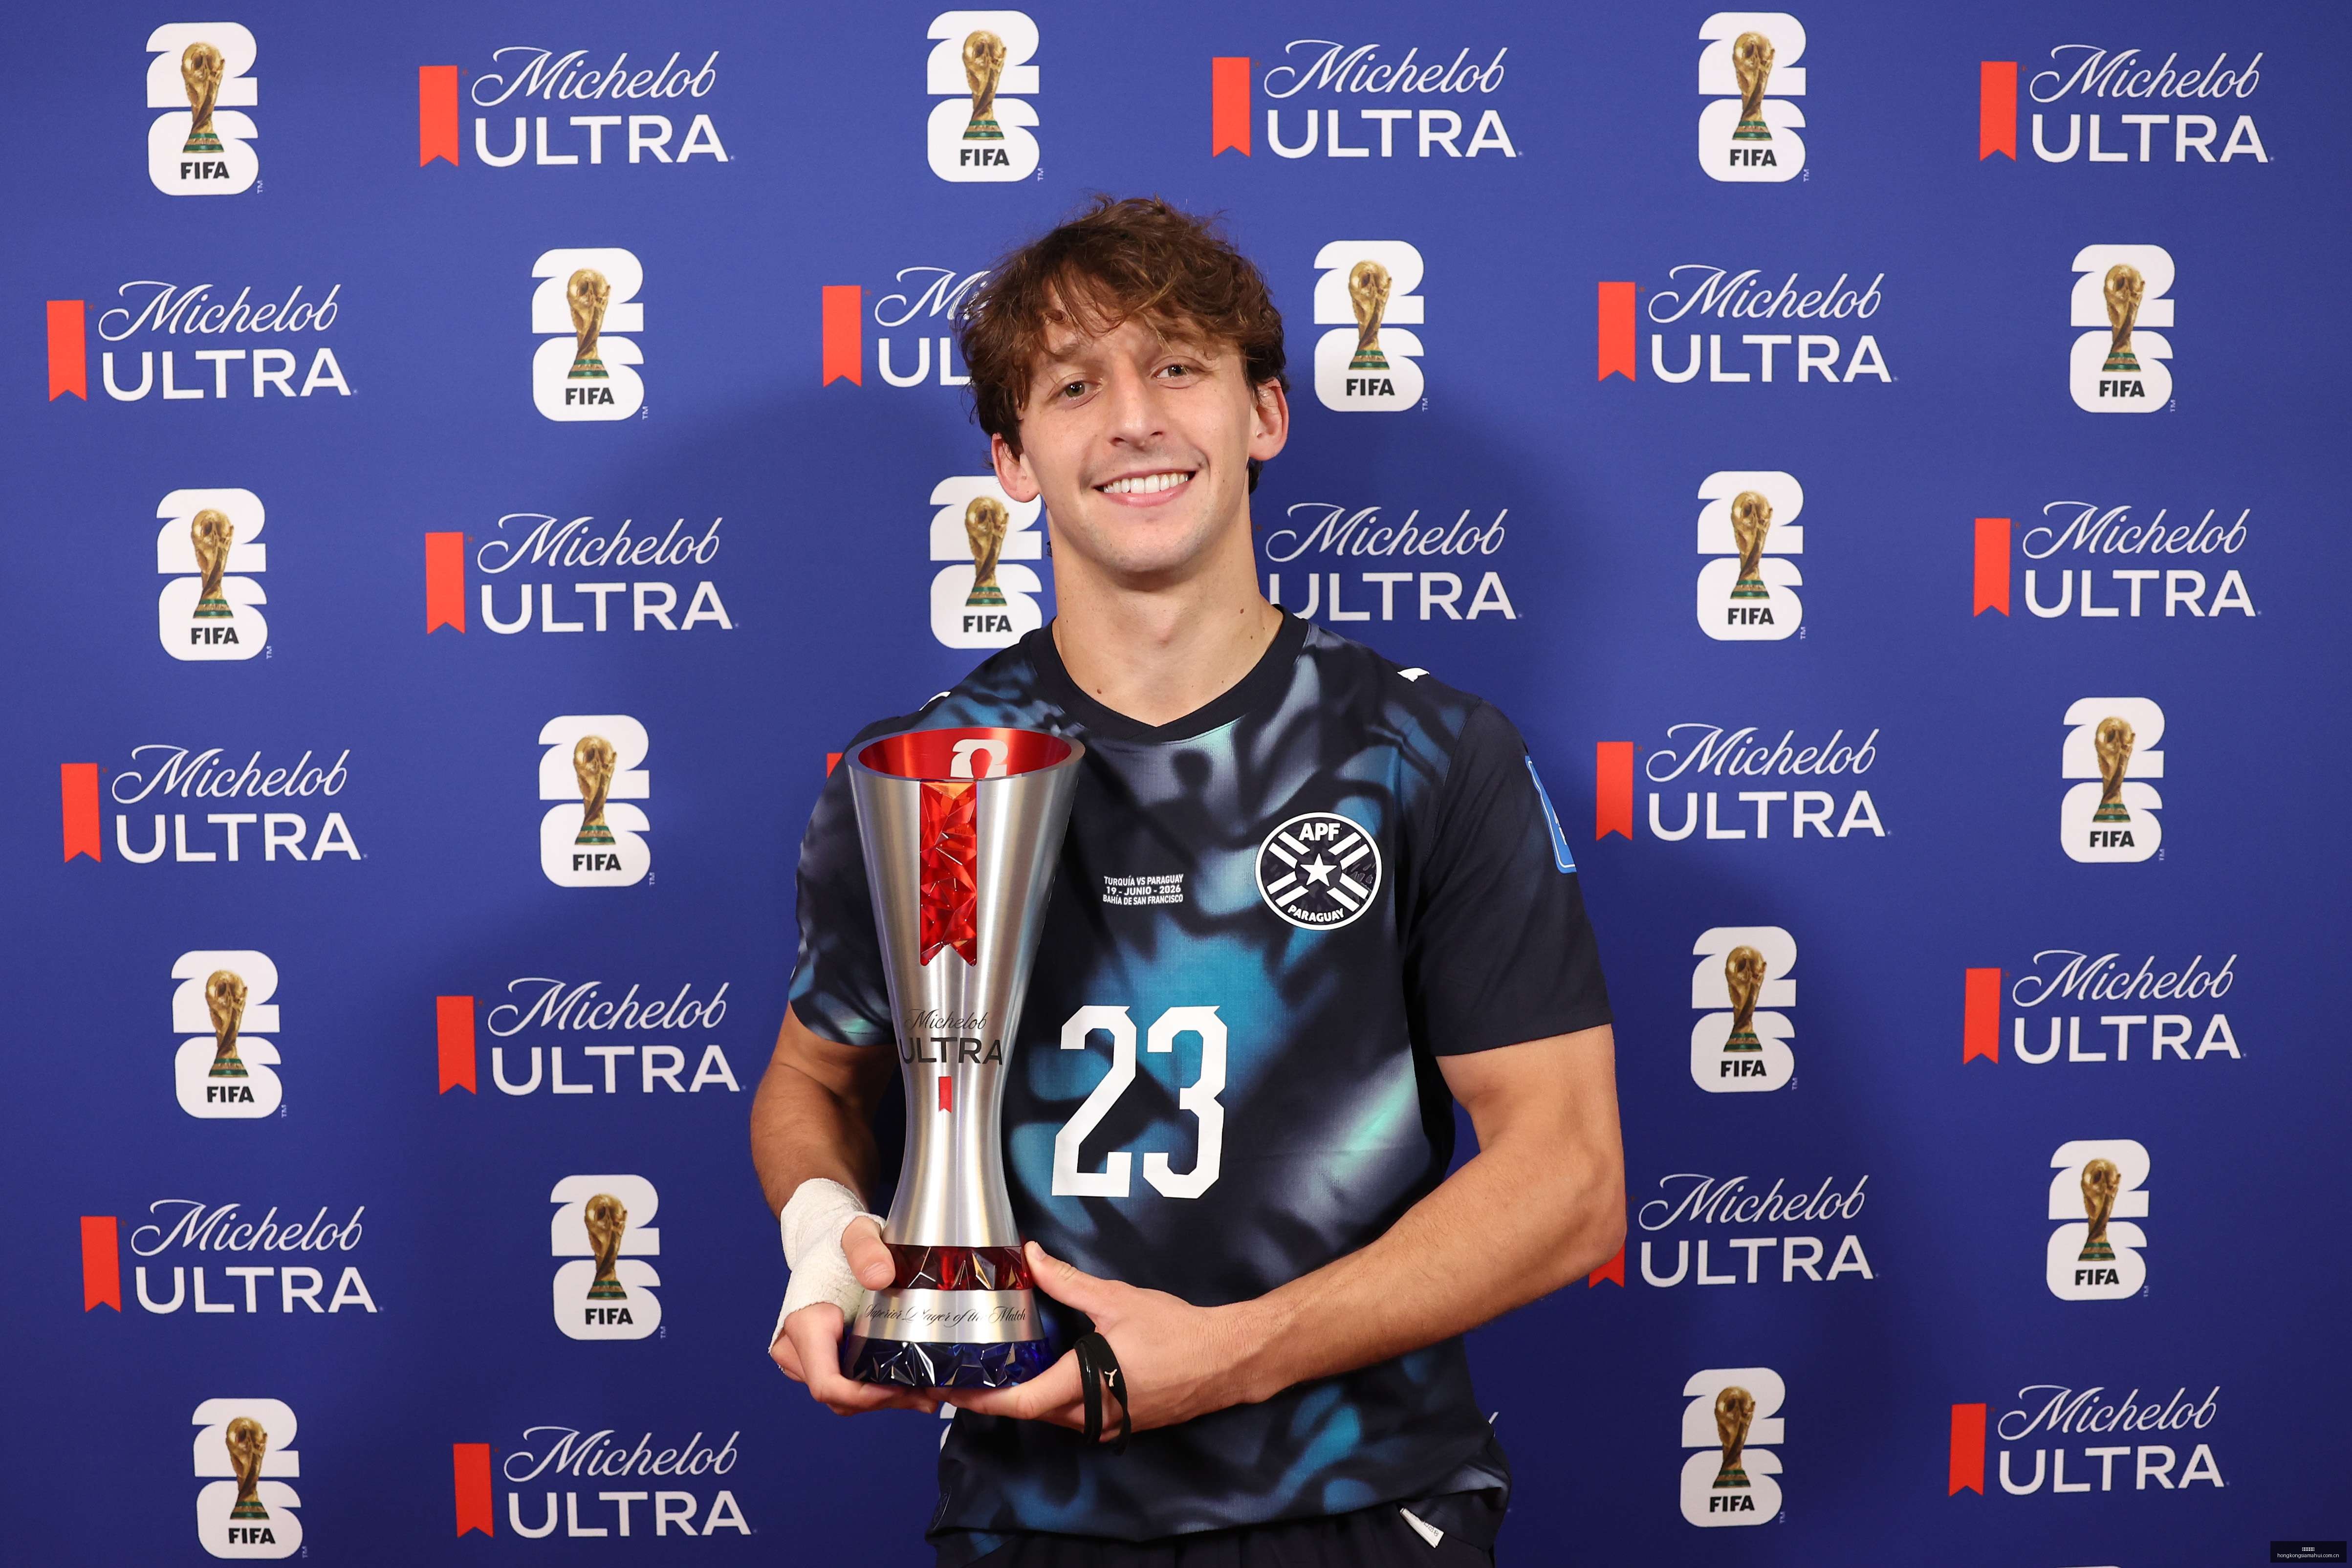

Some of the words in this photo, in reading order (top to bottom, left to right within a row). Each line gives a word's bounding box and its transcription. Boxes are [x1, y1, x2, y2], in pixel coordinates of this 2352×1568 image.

[472, 46, 719, 107] Michelob
[1264, 40, 1507, 98] Michelob
[2030, 44, 2263, 103] Michelob
[476, 114, 728, 167] ULTRA
[960, 149, 1009, 166] FIFA
[1268, 109, 1516, 158] ULTRA
[1730, 149, 1777, 166] FIFA
[2032, 114, 2268, 163] ULTRA
[181, 162, 229, 179] FIFA
[99, 281, 341, 341] Michelob
[1648, 264, 1884, 323] Michelob
[103, 348, 351, 401] ULTRA
[1652, 334, 1892, 383] ULTRA
[566, 388, 614, 405] FIFA
[1347, 379, 1395, 396] FIFA
[2099, 380, 2145, 397] FIFA
[477, 513, 722, 573] Michelob
[1265, 502, 1508, 563] Michelob
[2023, 501, 2250, 559] Michelob
[481, 581, 733, 634] ULTRA
[1269, 571, 1517, 621] ULTRA
[1728, 608, 1774, 625] FIFA
[2025, 570, 2256, 618] ULTRA
[191, 628, 239, 644] FIFA
[963, 615, 1012, 632] FIFA
[112, 744, 350, 804] Michelob
[1646, 723, 1879, 782] Michelob
[116, 812, 361, 863] ULTRA
[1299, 822, 1341, 841] APF
[1649, 790, 1885, 841] ULTRA
[2090, 831, 2134, 847] FIFA
[573, 854, 621, 871] FIFA
[1104, 875, 1135, 886] TURQUÍA
[1136, 877, 1145, 885] VS
[1147, 873, 1184, 885] PARAGUAY
[1103, 894, 1122, 905] BAHÍA
[1133, 896, 1146, 905] SAN
[1147, 894, 1183, 904] FRANCISCO
[1106, 886, 1117, 894] 19
[1124, 886, 1152, 895] JUNIO
[1159, 885, 1181, 893] 2026
[1287, 904, 1345, 922] PARAGUAY
[2012, 950, 2237, 1007] Michelob
[488, 978, 729, 1036] Michelob
[904, 1008, 988, 1030] Michelob
[899, 1037, 1003, 1065] ULTRA
[2014, 1014, 2241, 1064] ULTRA
[492, 1045, 740, 1095] ULTRA
[1720, 1060, 1766, 1077] FIFA
[207, 1086, 254, 1103] FIFA
[1052, 1005, 1227, 1198] 23
[1638, 1173, 1869, 1231] Michelob
[131, 1199, 365, 1256] Michelob
[1640, 1235, 1874, 1287] ULTRA
[2075, 1269, 2119, 1285] FIFA
[136, 1266, 377, 1314] ULTRA
[865, 1304, 902, 1321] Superior
[989, 1306, 1025, 1324] Match
[585, 1308, 633, 1325] FIFA
[1998, 1385, 2220, 1440] Michelob
[504, 1426, 740, 1482] Michelob
[2000, 1444, 2224, 1495] ULTRA
[508, 1490, 751, 1538] ULTRA
[1709, 1495, 1755, 1513] FIFA
[228, 1528, 276, 1544] FIFA
